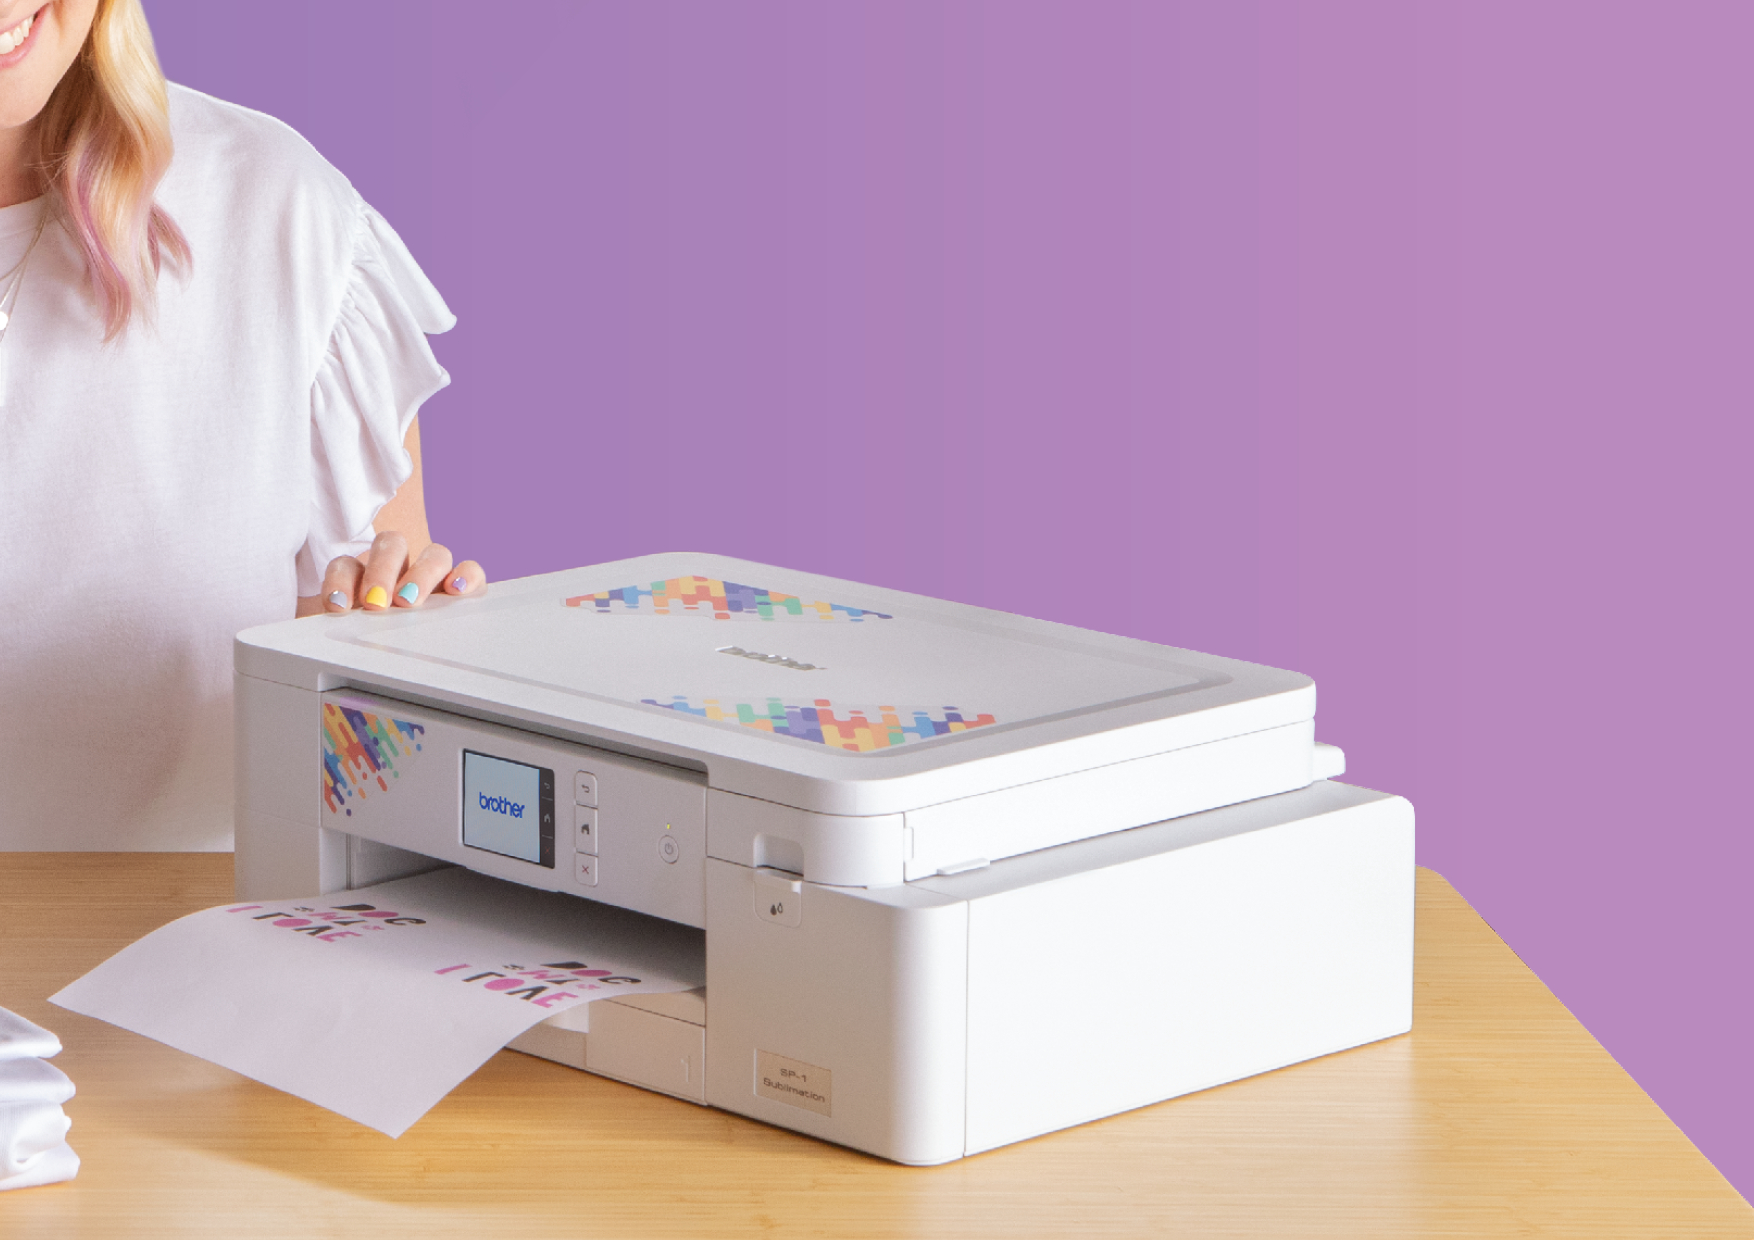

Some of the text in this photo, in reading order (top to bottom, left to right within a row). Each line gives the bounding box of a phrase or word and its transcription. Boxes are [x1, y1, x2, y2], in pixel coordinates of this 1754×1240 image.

[478, 791, 525, 818] brother
[779, 1067, 807, 1083] SP-1
[763, 1076, 826, 1103] Sublimation
